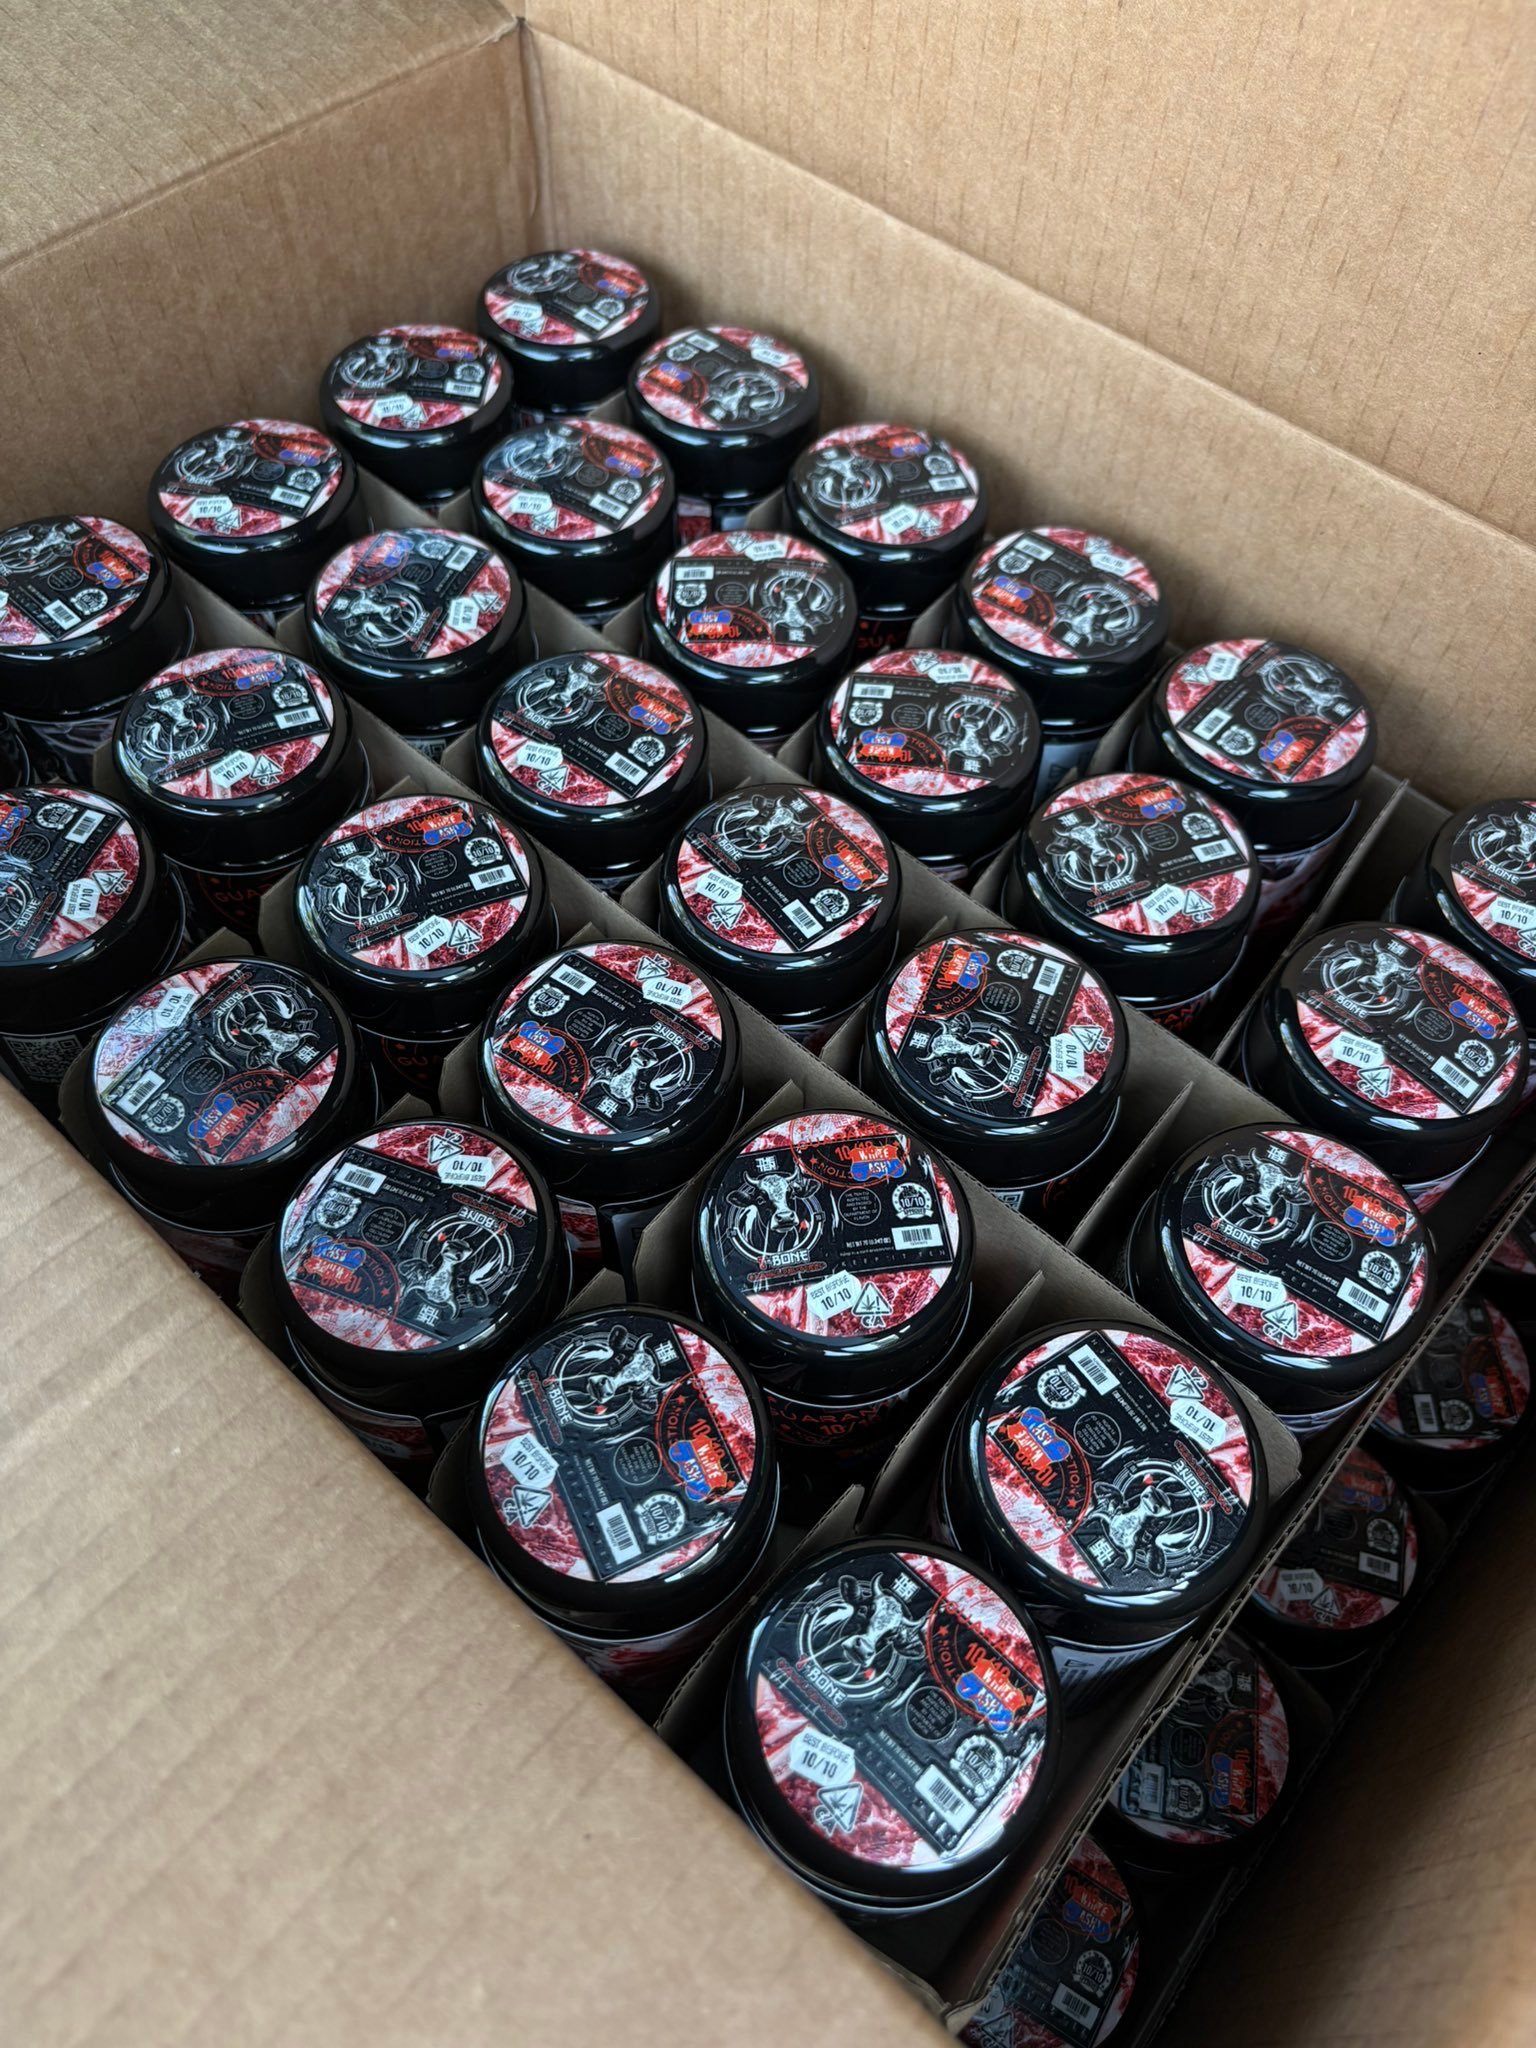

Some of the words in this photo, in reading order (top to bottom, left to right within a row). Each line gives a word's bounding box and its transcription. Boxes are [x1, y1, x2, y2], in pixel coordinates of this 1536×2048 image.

[79, 889, 94, 910] 10/10
[705, 881, 729, 898] 10/10
[1155, 896, 1179, 915] 10/10
[418, 928, 444, 948] 10/10
[654, 981, 680, 995] 10/10
[1065, 1044, 1077, 1067] 10/10
[1343, 1045, 1370, 1063] 10/10
[452, 1160, 480, 1171] 10/10
[900, 1196, 925, 1207] 10/10
[1369, 1262, 1393, 1282] 10/10
[821, 1287, 851, 1309] 10/10
[1241, 1286, 1271, 1302] 10/10
[1050, 1373, 1073, 1398] 10/10
[1184, 1405, 1214, 1431] 10/10
[512, 1450, 540, 1480] 10/10
[649, 1504, 669, 1534] 10/10
[802, 1750, 837, 1779] 10/10
[965, 1751, 992, 1782] 10/10
